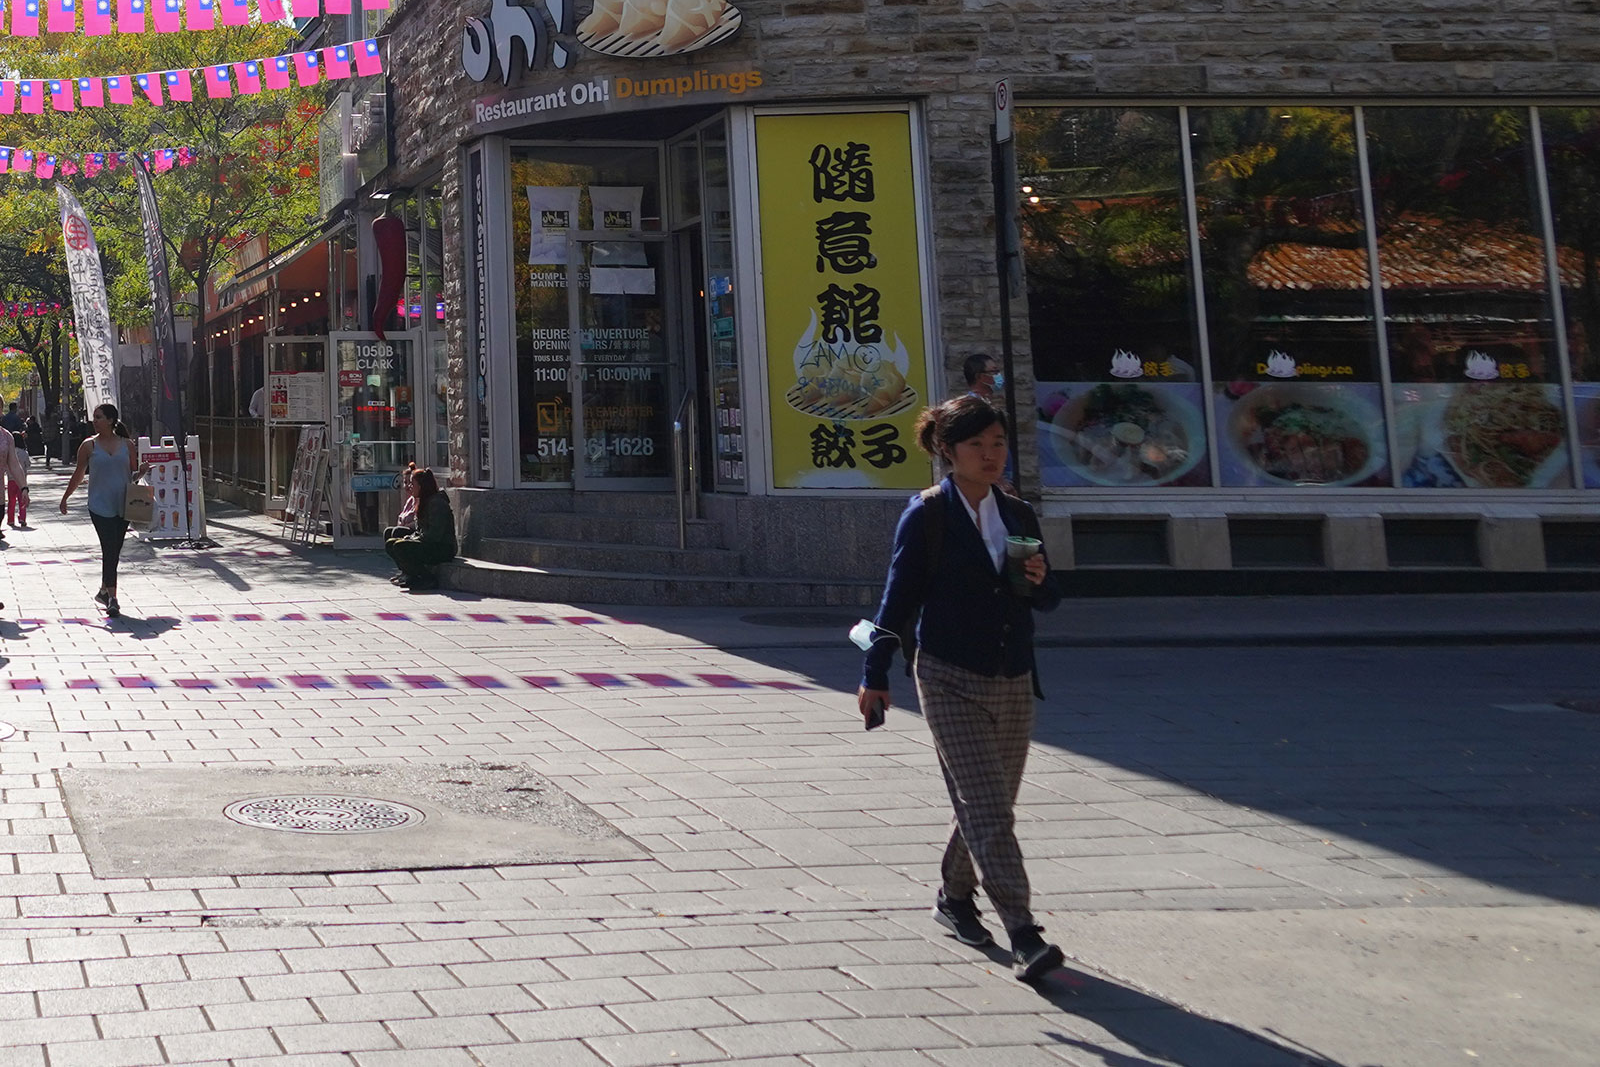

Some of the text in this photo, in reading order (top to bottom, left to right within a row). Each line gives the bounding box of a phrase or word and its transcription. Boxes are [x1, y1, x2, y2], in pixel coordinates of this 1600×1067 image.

[475, 69, 762, 124] Restaurant Oh! Dumplings
[809, 141, 883, 345] 隨意館
[357, 345, 393, 357] 1050B
[357, 359, 393, 369] CLARK
[1257, 362, 1353, 377] Dplings.ca
[810, 423, 907, 469] 餃子
